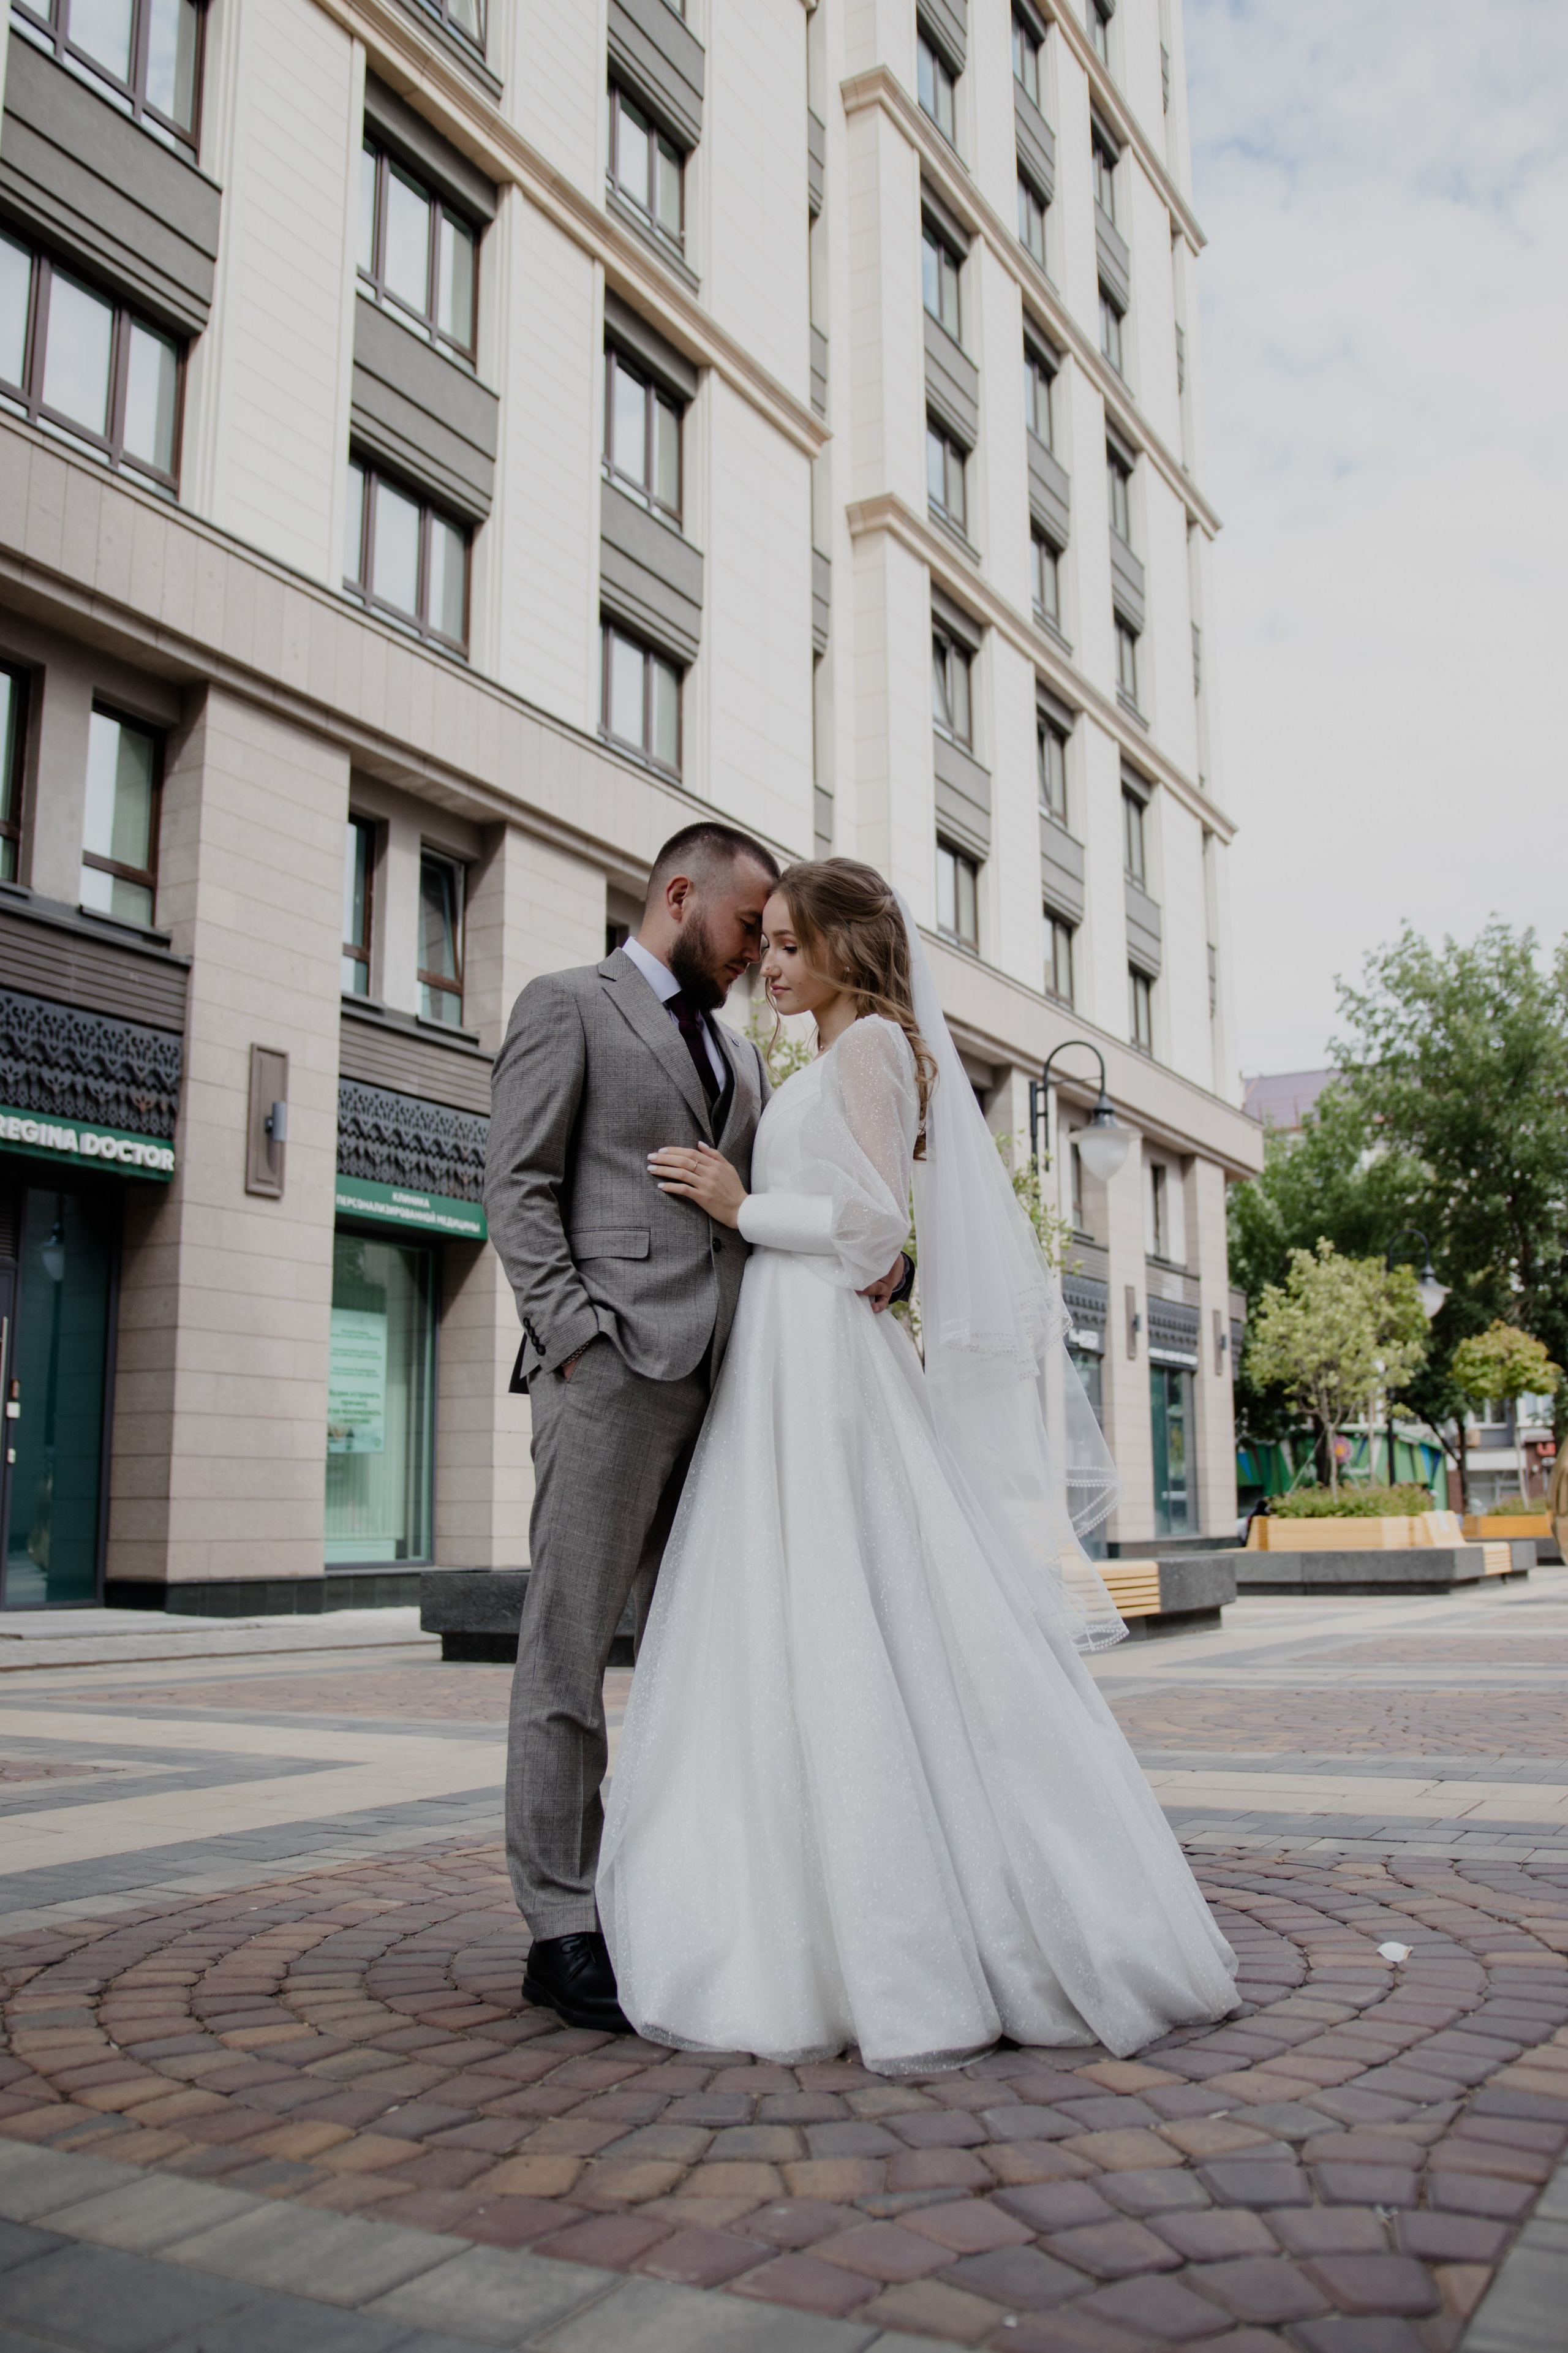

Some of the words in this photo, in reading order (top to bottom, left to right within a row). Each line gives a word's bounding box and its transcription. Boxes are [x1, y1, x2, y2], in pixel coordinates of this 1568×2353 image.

[80, 1132, 175, 1171] DOCTOR
[336, 1193, 435, 1223] ПЕРСОНАЛИЗИРОВАННОЙ
[436, 1214, 480, 1233] МЕДИЦИНЫ
[392, 1192, 430, 1208] КЛИНИКА
